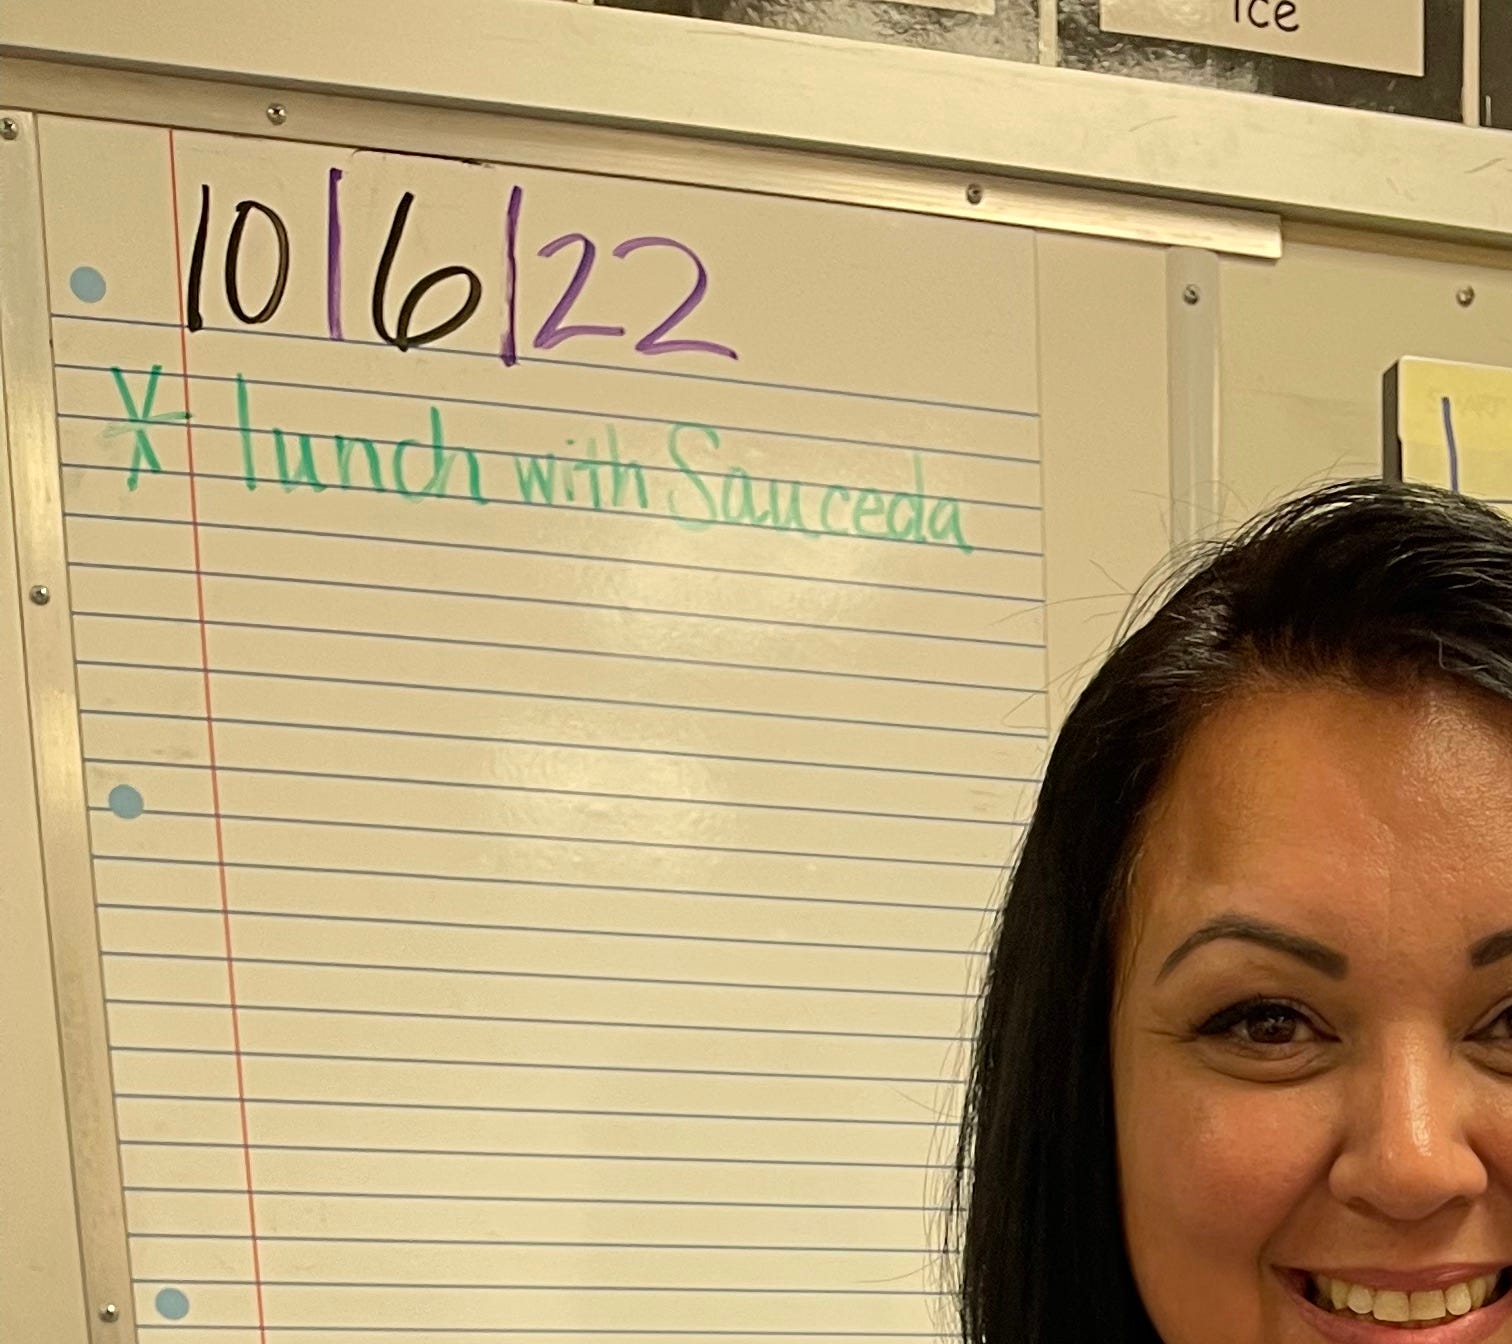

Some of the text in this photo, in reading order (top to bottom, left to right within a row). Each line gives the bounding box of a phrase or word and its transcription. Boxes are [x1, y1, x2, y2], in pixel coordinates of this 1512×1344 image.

[235, 372, 976, 556] lunch with Sauceda
